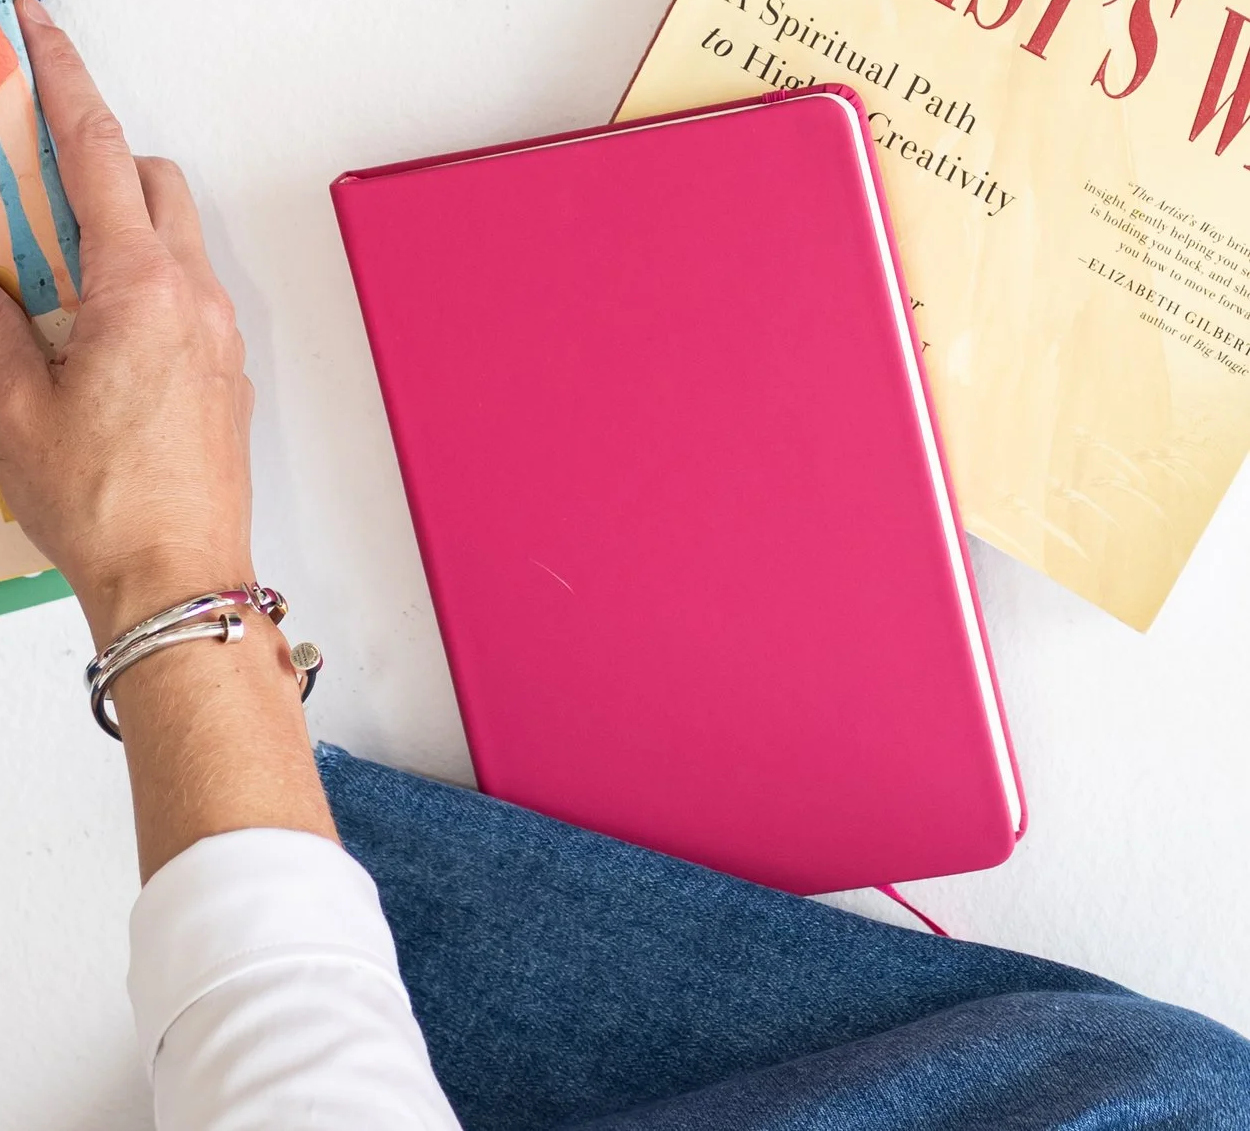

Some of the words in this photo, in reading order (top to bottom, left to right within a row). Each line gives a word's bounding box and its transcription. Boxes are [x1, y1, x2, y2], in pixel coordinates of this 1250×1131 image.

[701, 27, 734, 57] to
[740, 43, 817, 90] Hig
[868, 109, 1018, 217] Creativity
[903, 72, 978, 136] Path
[1083, 179, 1127, 213] insight,
[1129, 208, 1170, 235] gently
[1169, 225, 1216, 261] helping
[1214, 253, 1241, 272] you
[1090, 203, 1101, 218] is
[1103, 210, 1150, 246] holding
[1148, 238, 1173, 256] you
[1175, 249, 1205, 275] back,
[1208, 269, 1234, 289] and
[1154, 199, 1198, 227] Artist's
[1199, 221, 1226, 244] Way
[1226, 236, 1250, 262] brin
[1115, 241, 1141, 259] you
[1142, 252, 1168, 274] how
[1169, 269, 1183, 282] to
[1184, 277, 1218, 301] move
[1139, 310, 1179, 336] author
[1179, 333, 1195, 345] of
[1193, 338, 1215, 359] Big
[1215, 351, 1250, 378] Magic
